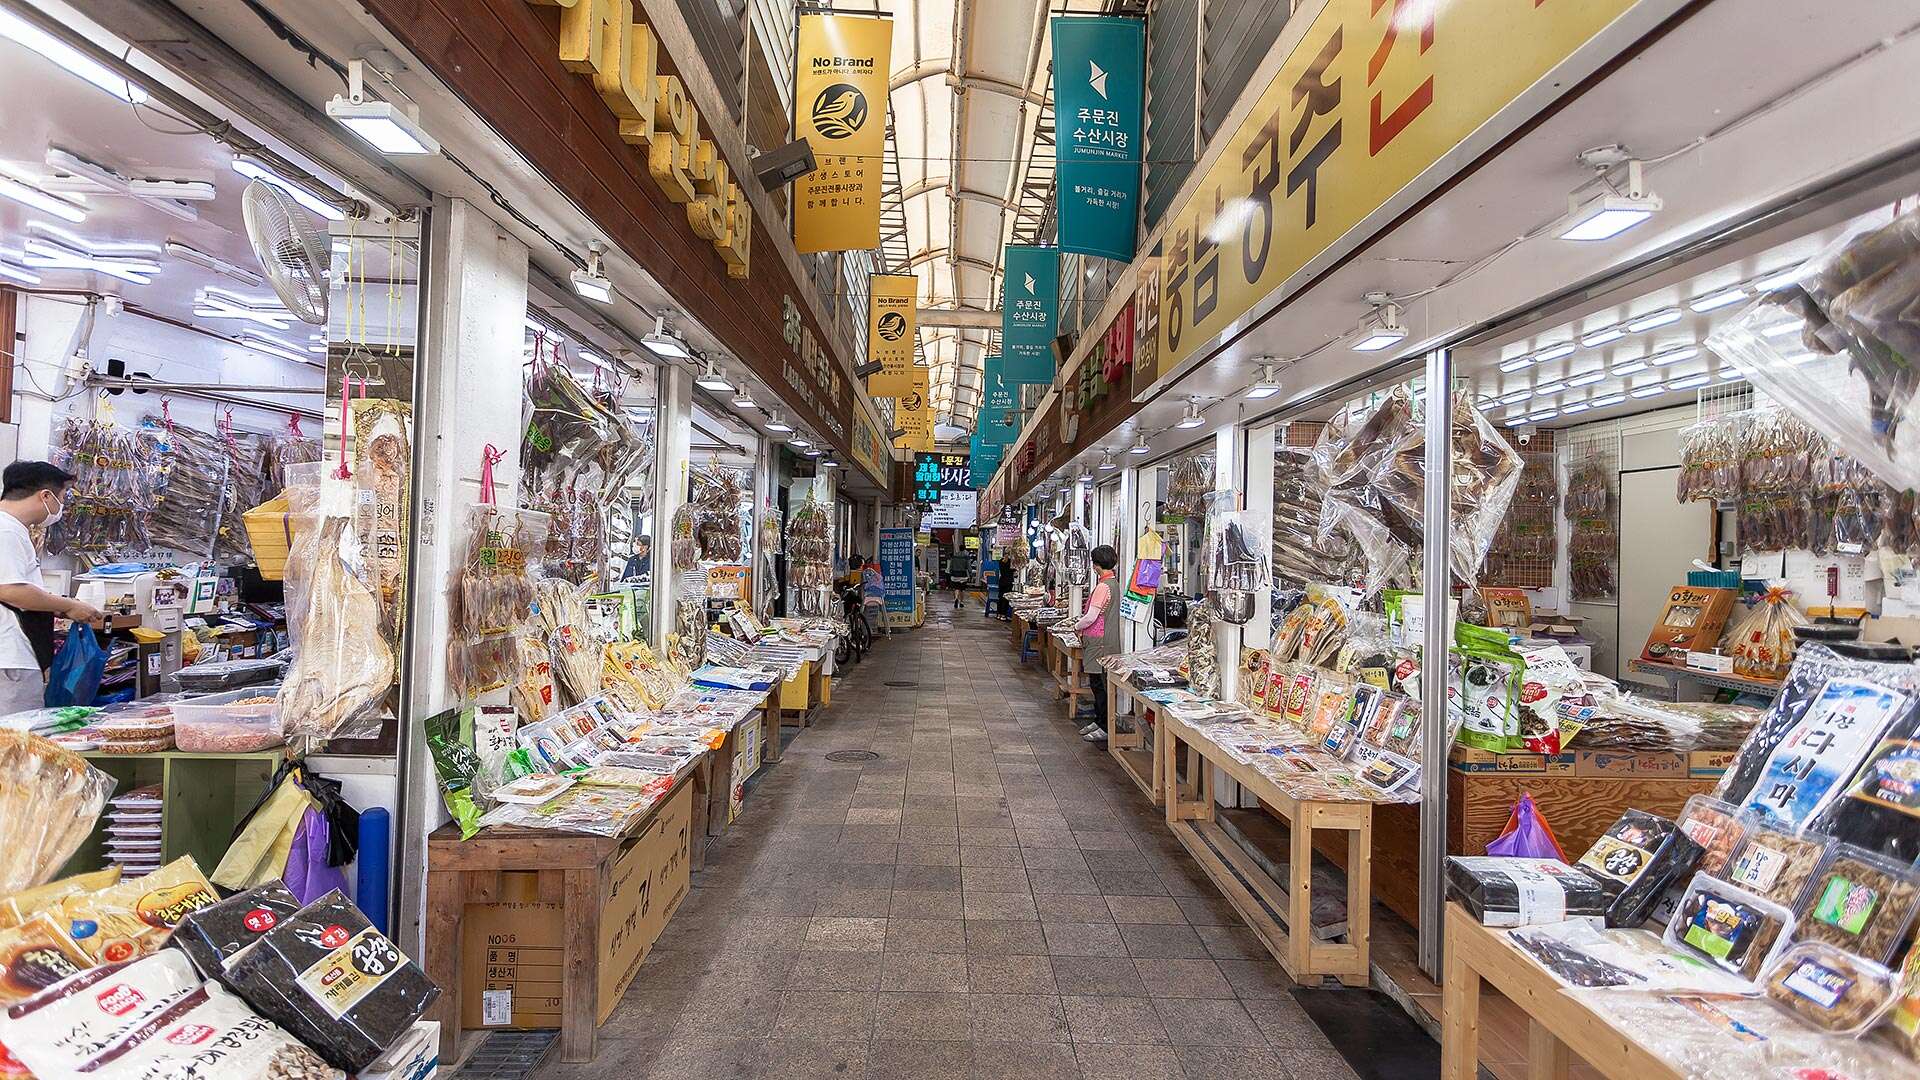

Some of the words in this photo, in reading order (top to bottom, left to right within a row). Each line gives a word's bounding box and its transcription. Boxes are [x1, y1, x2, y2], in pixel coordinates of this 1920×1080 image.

[813, 57, 830, 68] No
[833, 57, 873, 68] Brand
[1077, 108, 1119, 127] 주문진
[1073, 128, 1128, 148] 수산시장
[1105, 151, 1128, 160] MARKET
[1242, 23, 1343, 285] 공주
[807, 184, 864, 195] 주문진전통시장과
[1015, 300, 1041, 310] 주문진
[1012, 311, 1047, 322] 수산시장
[1768, 731, 1835, 809] 다시마
[354, 936, 398, 975] 곱창
[488, 966, 515, 978] 생산지
[102, 985, 133, 1008] FOOD
